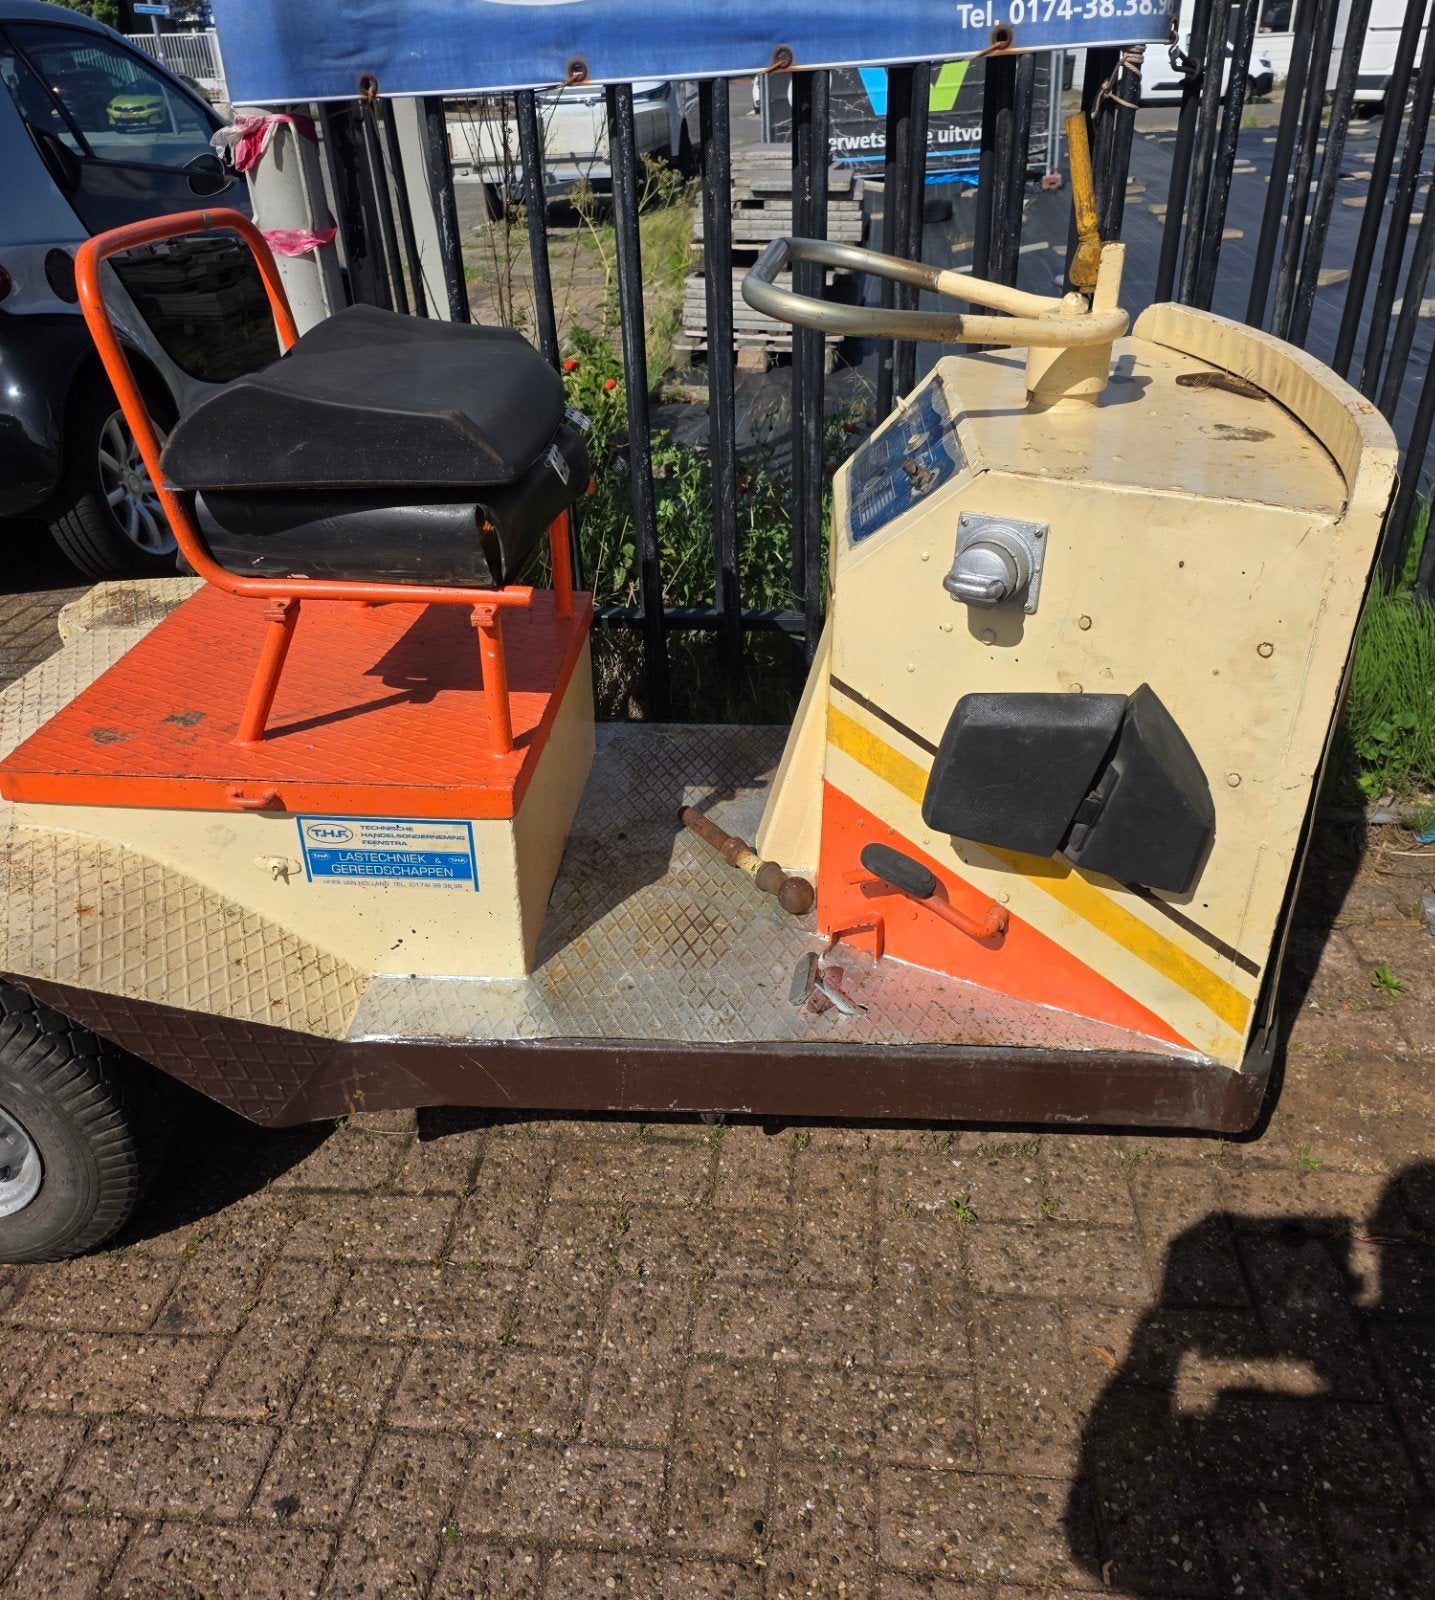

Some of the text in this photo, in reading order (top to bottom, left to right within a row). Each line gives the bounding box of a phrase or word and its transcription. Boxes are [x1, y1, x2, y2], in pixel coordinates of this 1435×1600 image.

[956, 1, 1000, 29] Tel.
[828, 132, 886, 151] erwets
[937, 125, 983, 143] uitvo
[360, 832, 465, 841] HANDELSONDERNEMING
[338, 852, 427, 864] LASTECHNIEK
[331, 864, 454, 877] GEREEDSCHAPPEN
